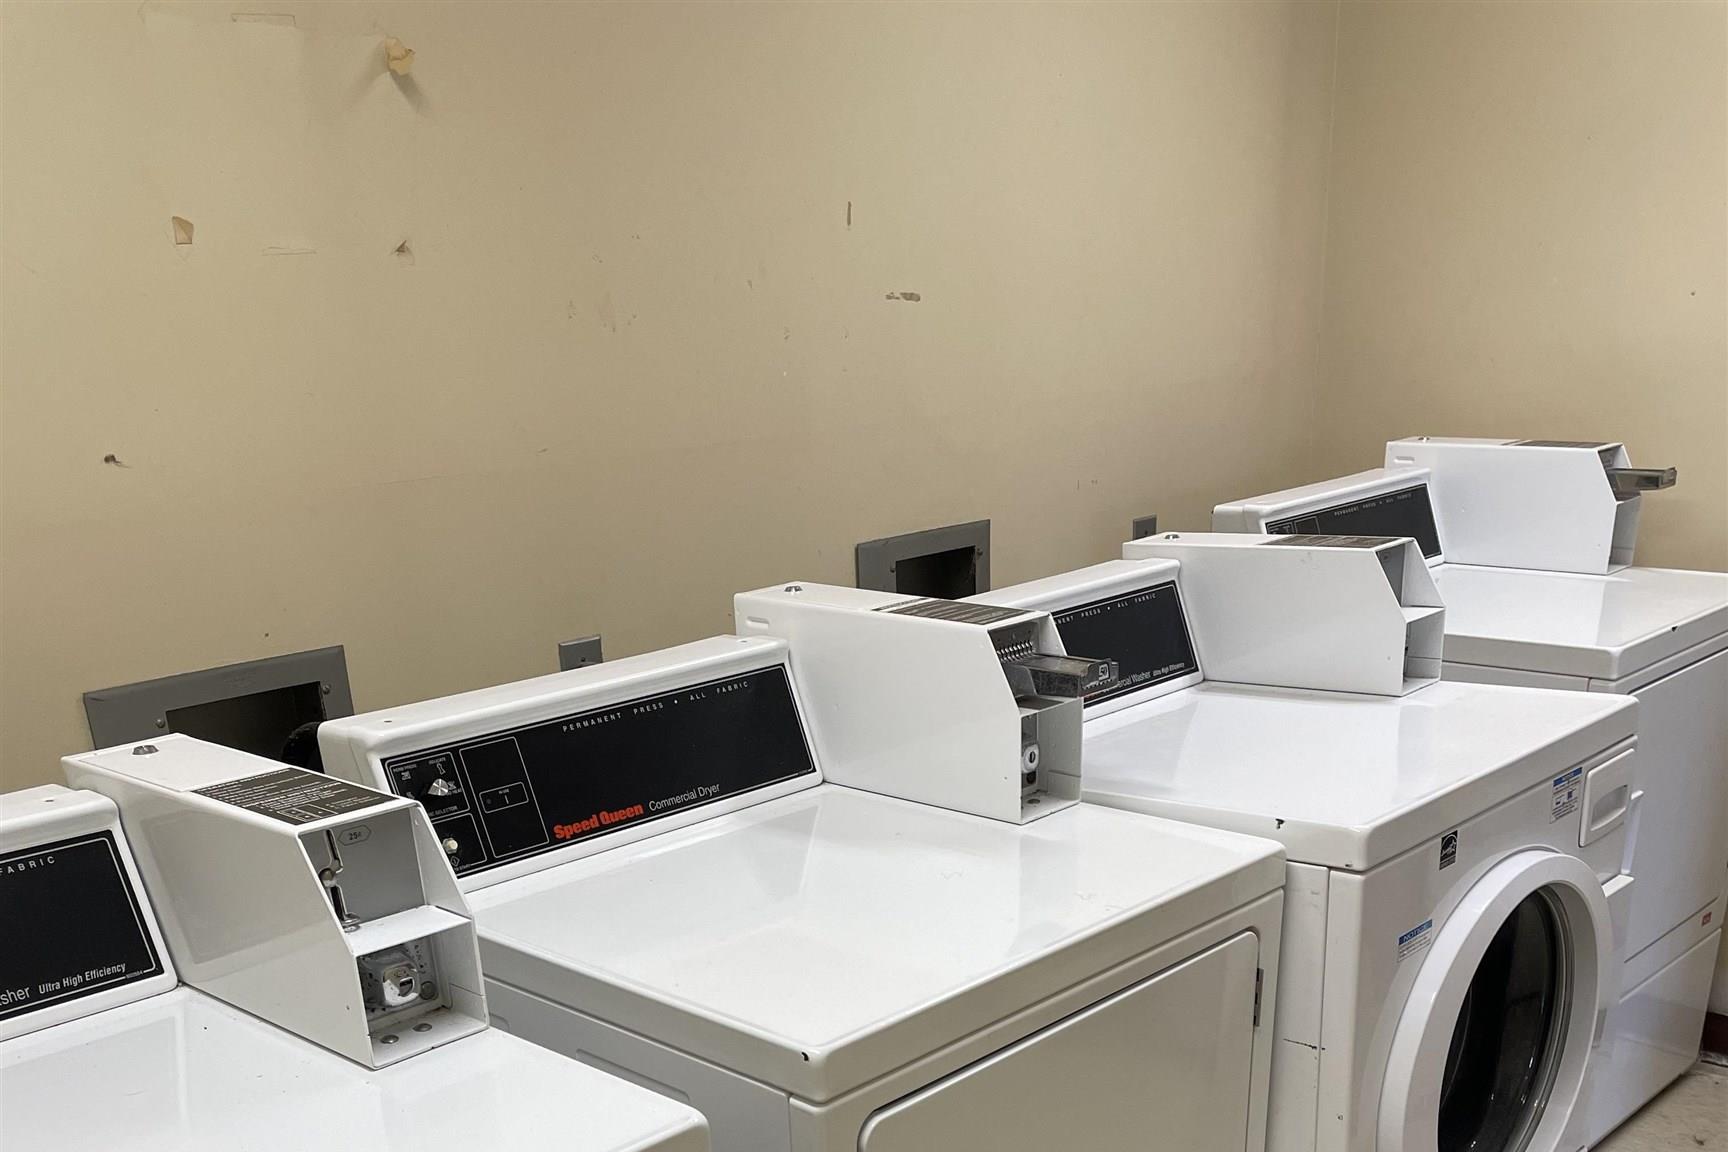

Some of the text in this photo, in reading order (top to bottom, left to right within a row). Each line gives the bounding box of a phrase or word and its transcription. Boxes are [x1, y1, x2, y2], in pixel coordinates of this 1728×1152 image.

[563, 681, 749, 732] PERMANENT PRESS ALL FABRIC
[553, 783, 720, 839] Speed Queen Commercial Dryer
[0, 986, 31, 1006] sher
[38, 981, 61, 995] Ultra
[62, 973, 83, 988] High
[85, 962, 126, 982] Efficiency
